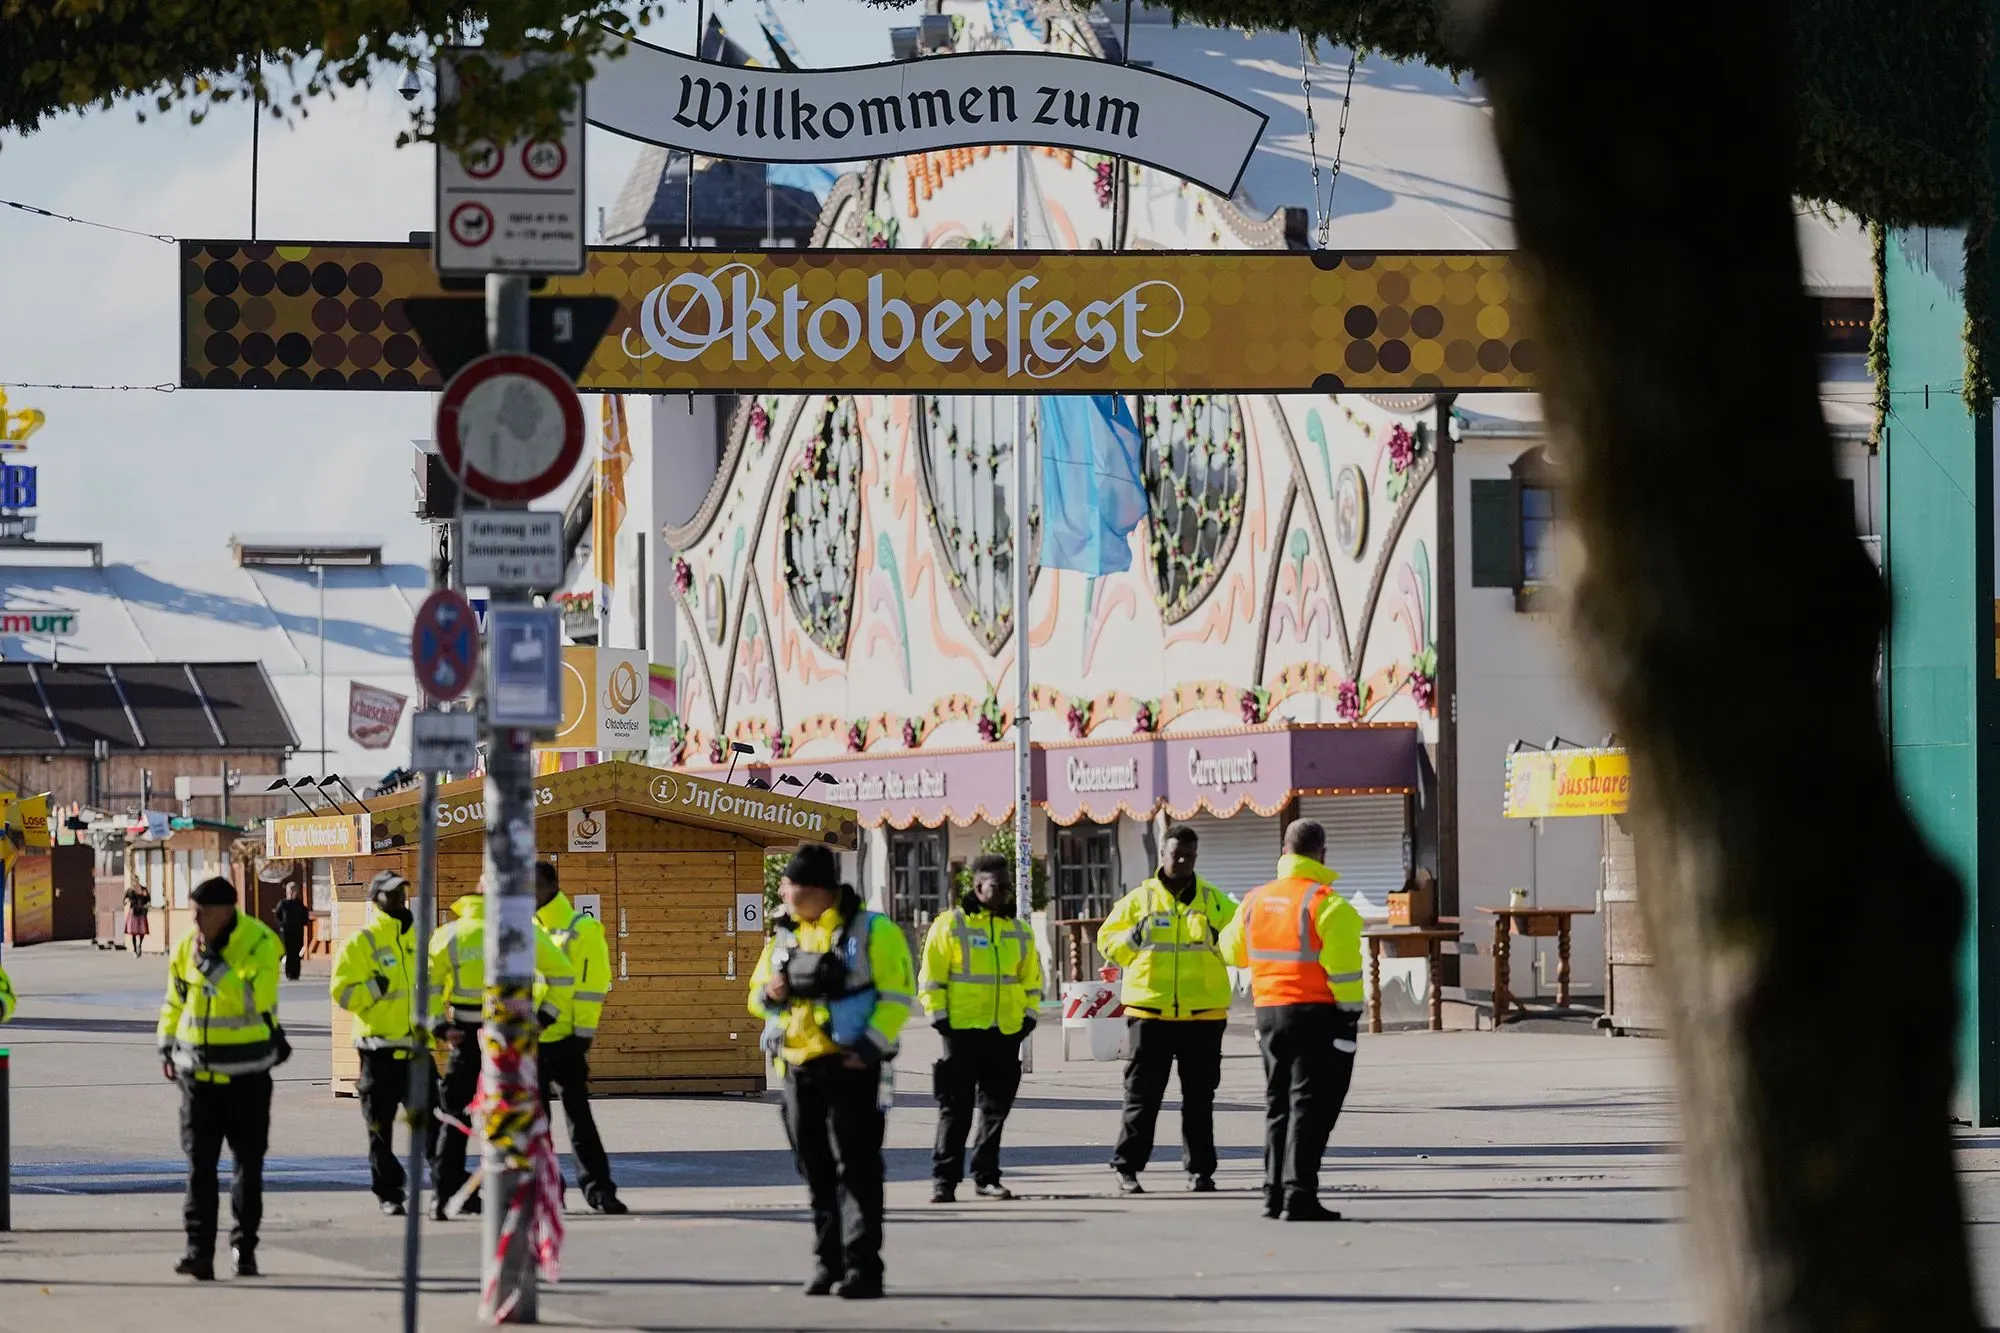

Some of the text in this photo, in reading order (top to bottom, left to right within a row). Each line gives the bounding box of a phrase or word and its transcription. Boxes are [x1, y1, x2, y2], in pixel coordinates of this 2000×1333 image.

[672, 74, 1138, 141] Willkommen zum
[621, 262, 1185, 379] Oktoberfest
[530, 521, 551, 537] mit
[0, 615, 73, 633] murr
[604, 718, 640, 732] Oktoberfest
[1187, 747, 1257, 793] Currywurst
[435, 787, 554, 828] Sours
[681, 781, 824, 832] Information
[21, 812, 46, 826] Lose
[582, 905, 595, 919] 5
[743, 904, 757, 921] 6
